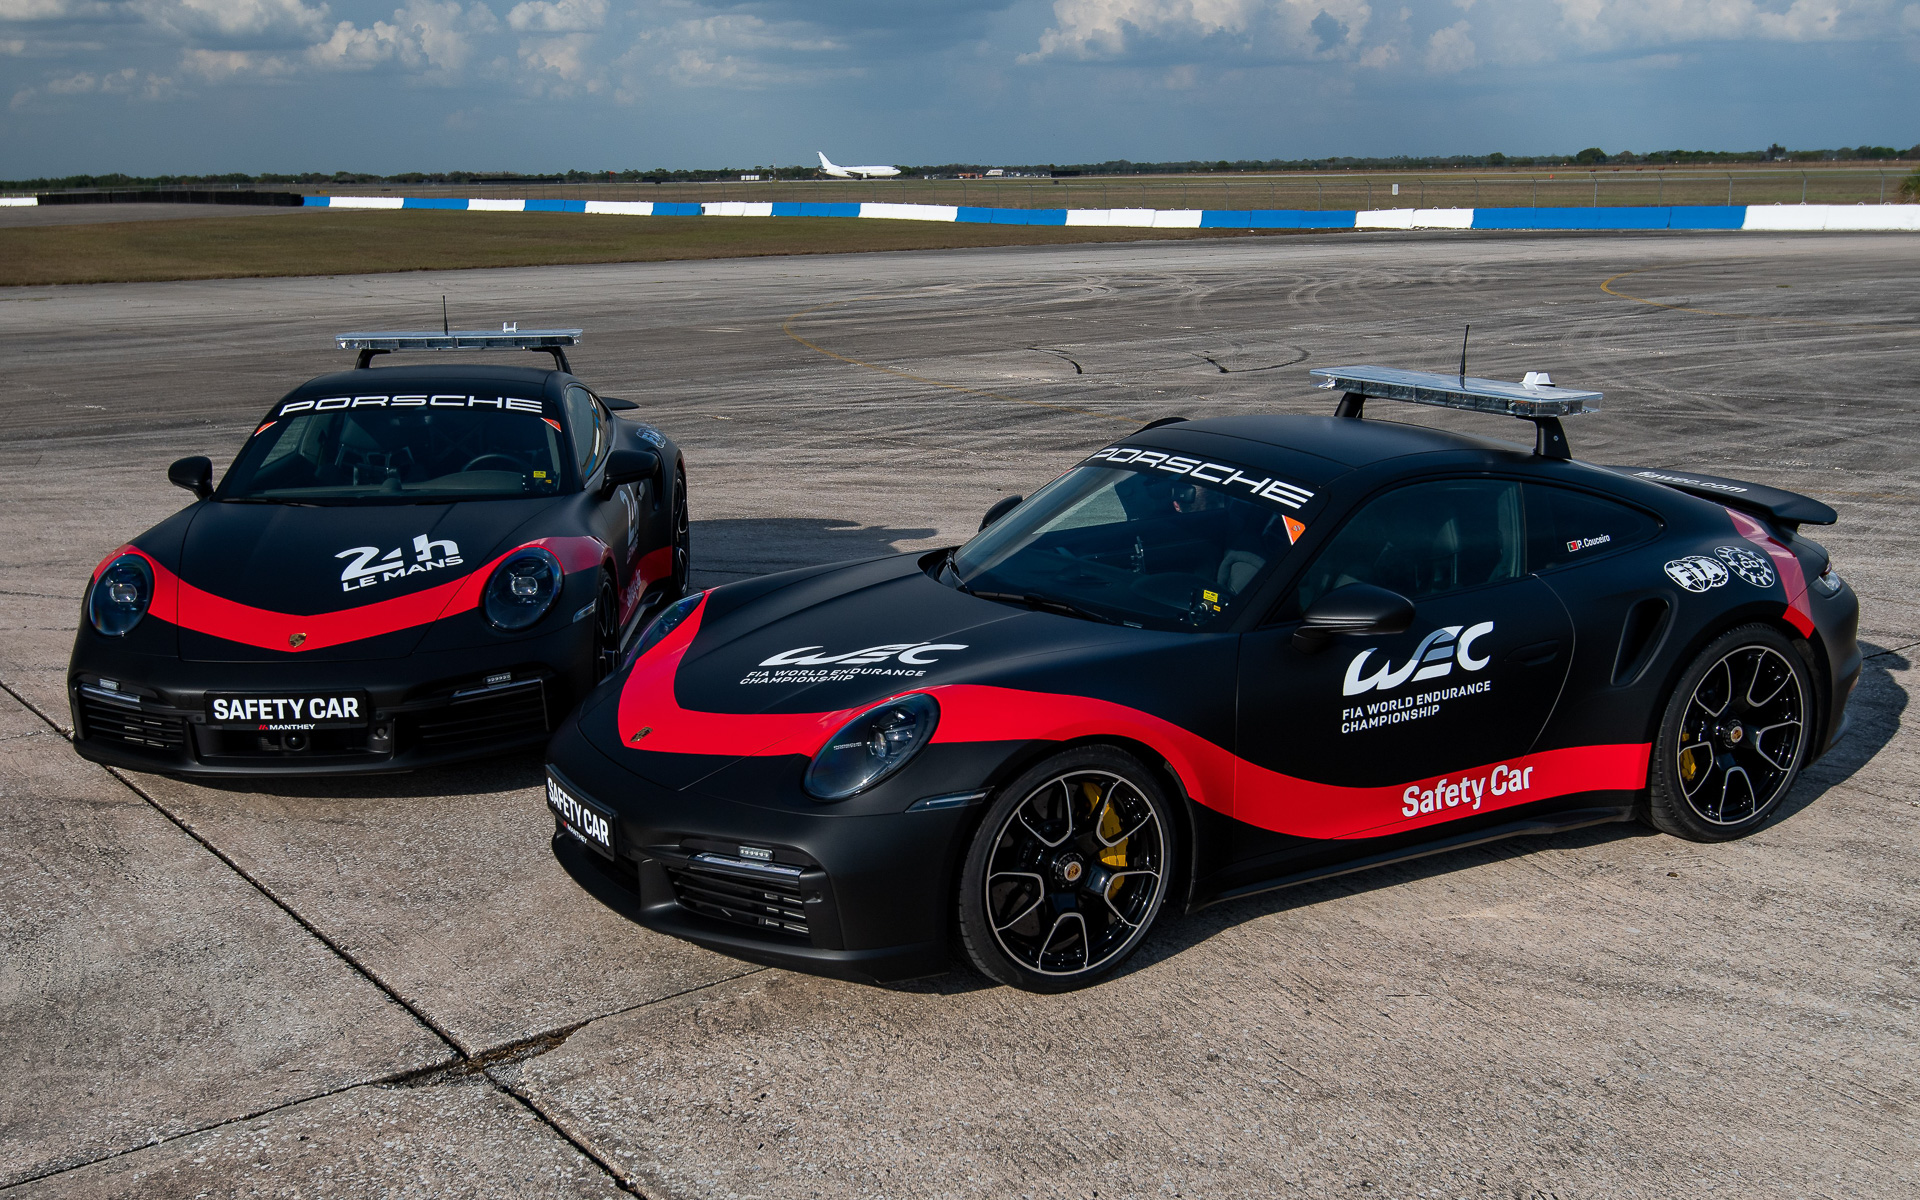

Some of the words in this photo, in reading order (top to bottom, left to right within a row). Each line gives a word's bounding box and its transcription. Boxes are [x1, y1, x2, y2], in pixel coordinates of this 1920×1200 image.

[279, 395, 543, 417] PORSCHE
[1086, 448, 1315, 510] PORSCHE
[334, 533, 460, 582] 24h
[342, 575, 378, 592] LE
[383, 555, 464, 582] MANS
[758, 641, 970, 667] WEC
[1342, 621, 1494, 697] WEC
[739, 674, 855, 685] CHAMPIONSHIP
[775, 669, 828, 678] WORLD
[832, 668, 927, 677] ENDURANCE
[213, 698, 305, 720] SAFETY
[309, 697, 360, 719] CAR
[1342, 707, 1364, 721] FIA
[1367, 696, 1413, 716] WORLD
[1416, 681, 1491, 706] ENDURANCE
[269, 723, 316, 731] MANTHEY
[1341, 704, 1440, 734] CHAMPIONSHIP
[1401, 776, 1487, 818] Safety
[1490, 764, 1534, 796] Car
[547, 776, 582, 828] SAFETY
[583, 808, 610, 847] CAR
[567, 823, 588, 844] MANTHEY
